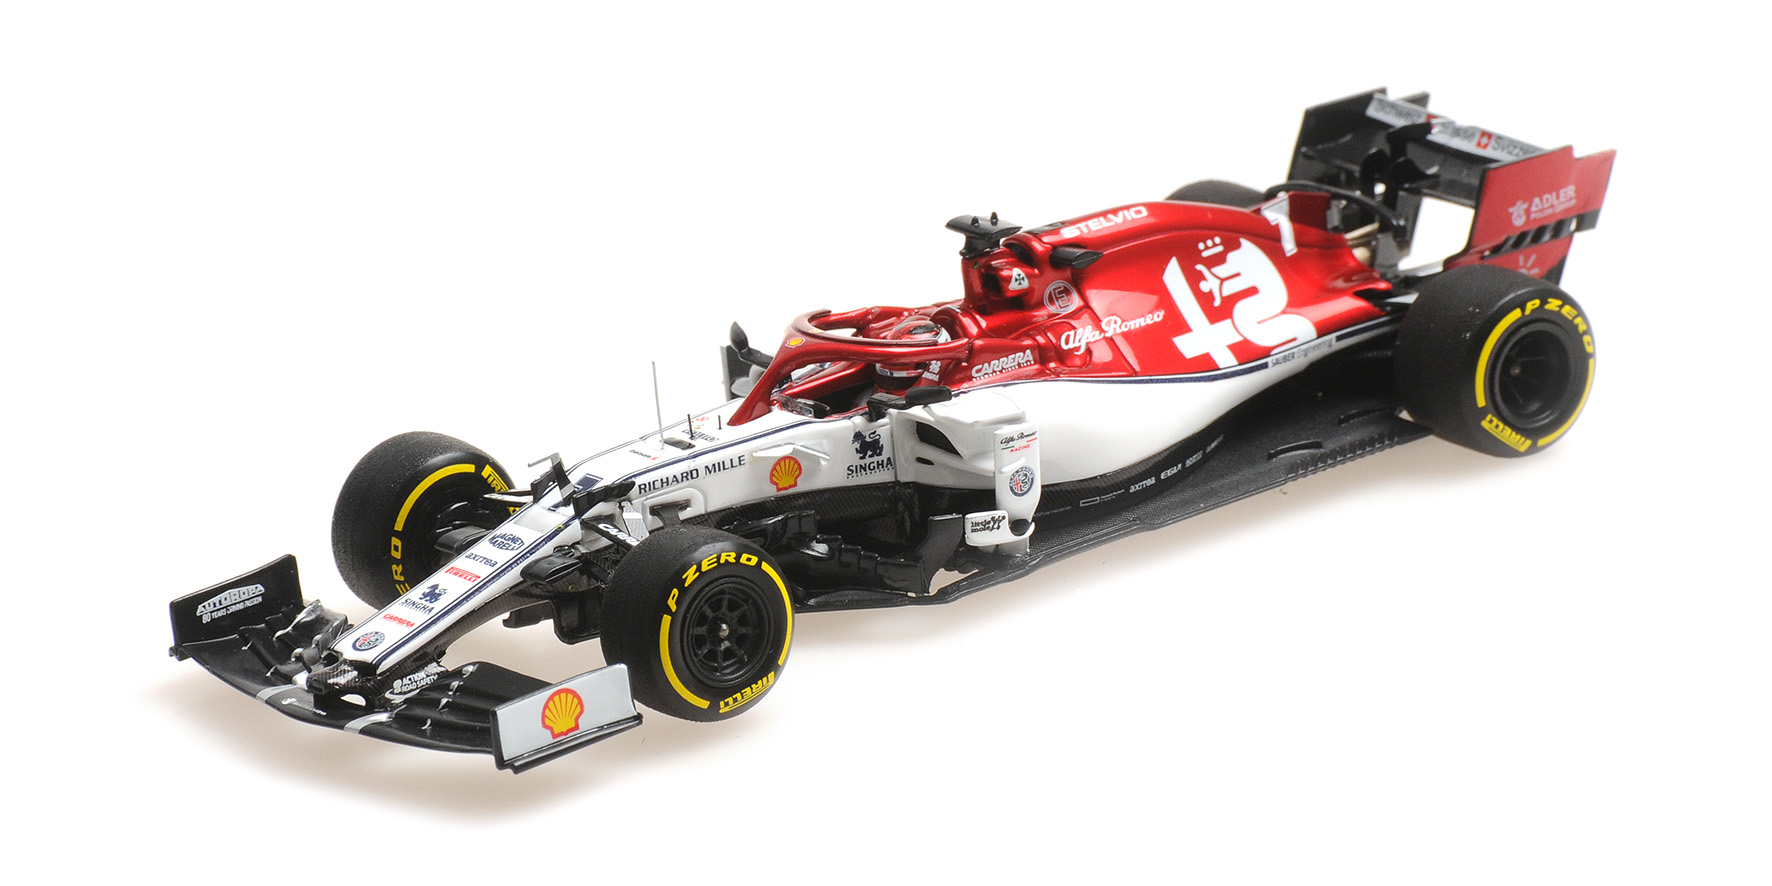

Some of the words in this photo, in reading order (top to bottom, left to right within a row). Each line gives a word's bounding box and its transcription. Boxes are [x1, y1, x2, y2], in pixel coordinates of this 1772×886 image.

[1530, 184, 1576, 212] ADLER
[1060, 206, 1149, 239] STELVIO
[1060, 325, 1104, 355] Alfa
[1101, 309, 1165, 338] Romeo
[1524, 298, 1541, 315] P
[1544, 298, 1594, 354] ZERO
[971, 349, 1034, 377] CARRERA
[638, 468, 699, 495] RICHARD
[704, 455, 746, 476] MILLE
[846, 456, 893, 476] SINGHA
[444, 566, 481, 583] PIRELLI
[667, 588, 679, 612] P
[682, 552, 758, 587] ZERO
[401, 597, 435, 614] SINGHA
[402, 670, 427, 685] ACTION
[719, 671, 775, 713] PIRELLI
